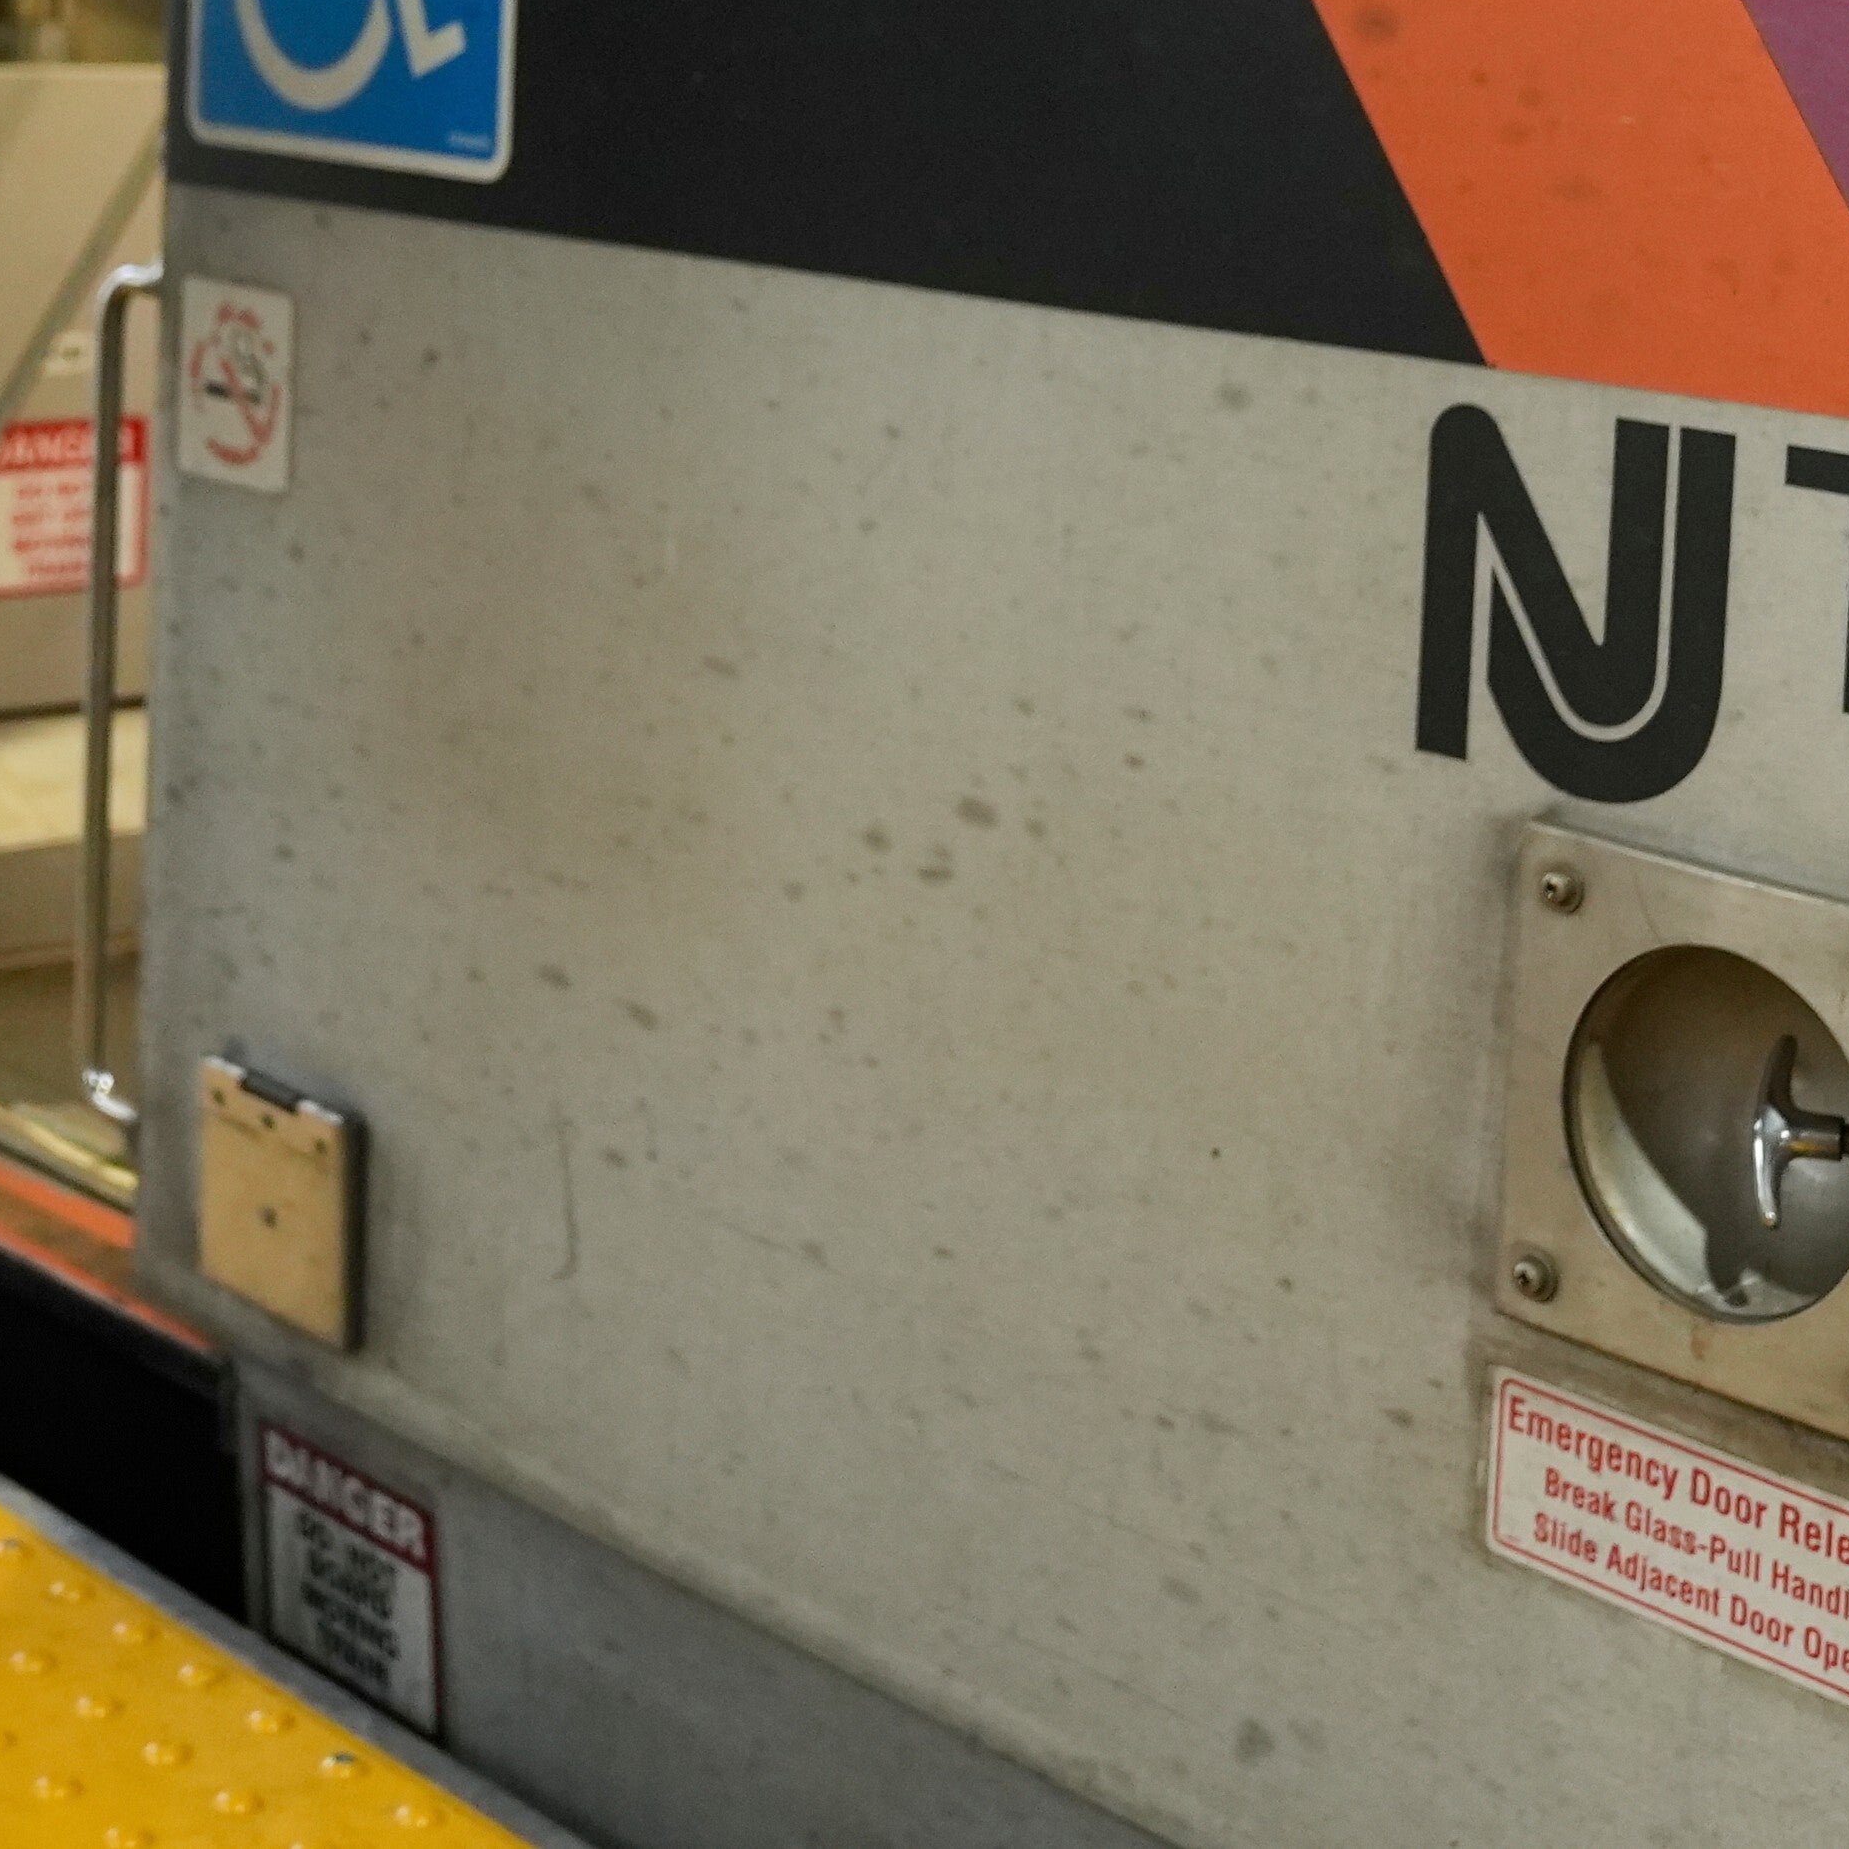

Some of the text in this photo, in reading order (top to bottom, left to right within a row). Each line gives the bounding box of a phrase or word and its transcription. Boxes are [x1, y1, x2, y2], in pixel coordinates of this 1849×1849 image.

[1416, 402, 1736, 804] NJ
[1508, 1396, 1679, 1500] Emergency
[1690, 1468, 1768, 1528] Door
[1544, 1468, 1617, 1521] Break
[1625, 1502, 1761, 1583] Glass-Pull
[1534, 1513, 1598, 1563] Slide
[1606, 1545, 1721, 1618] Adjacent
[1731, 1596, 1795, 1647] Door
